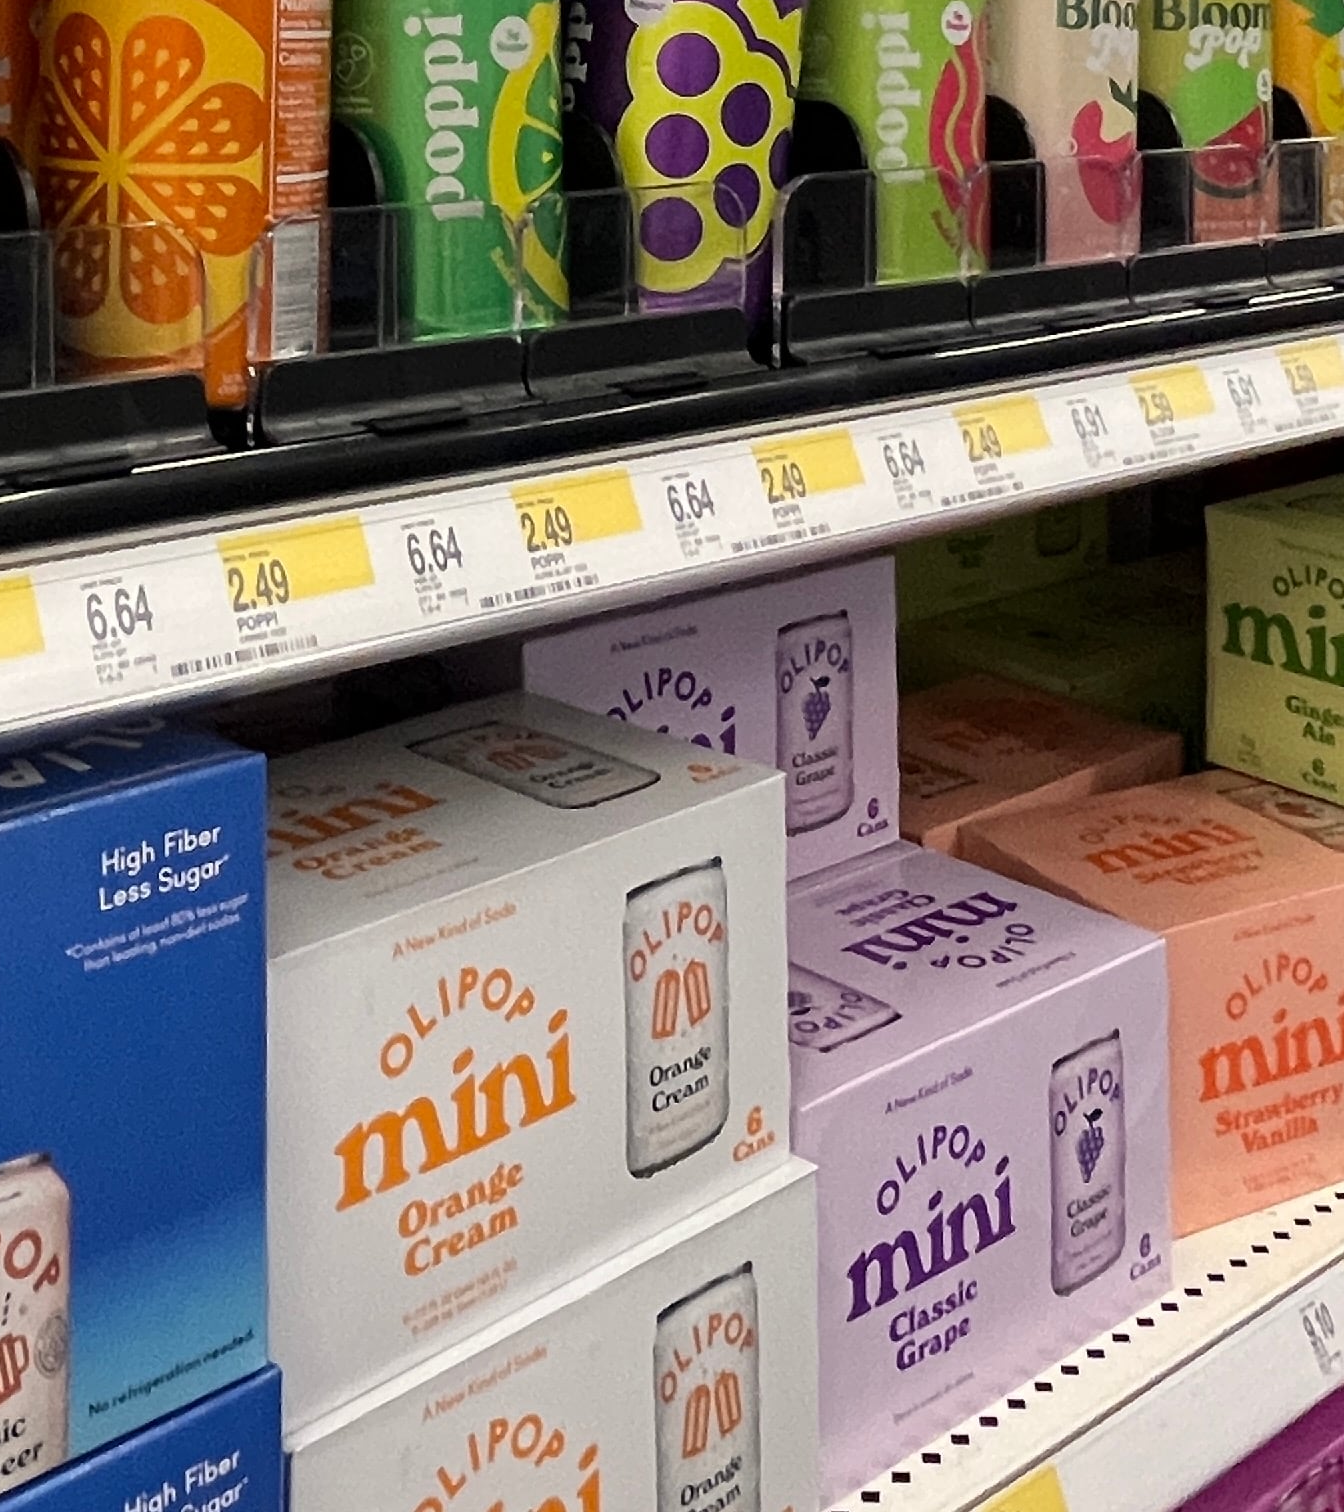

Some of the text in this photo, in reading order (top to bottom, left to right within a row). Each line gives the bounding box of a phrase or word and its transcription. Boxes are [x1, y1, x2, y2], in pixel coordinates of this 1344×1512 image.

[1183, 26, 1263, 72] Pop
[403, 10, 485, 223] poppi
[861, 8, 925, 185] poppi
[883, 439, 926, 480] 6.64
[961, 423, 1002, 462] 2.49
[666, 479, 716, 524] 6.64
[759, 462, 808, 506] 2.49
[406, 526, 463, 576] 6.64
[520, 505, 573, 555] 2.49
[86, 584, 154, 641] 6.64
[227, 558, 290, 614] 2.49
[236, 610, 280, 634] POPPI
[779, 639, 851, 695] OLIPOP
[1301, 719, 1337, 748] Ale
[865, 797, 880, 820] 6
[100, 824, 224, 879] High Fiber
[1084, 817, 1256, 875] mini
[97, 879, 153, 912] Less
[436, 920, 470, 947] Kind
[628, 900, 726, 983] OLIPOP
[841, 890, 1019, 972] mini
[1226, 950, 1330, 1023] OLIPOP
[379, 964, 536, 1080] OLIPOP
[647, 1043, 713, 1088] Orange
[650, 1070, 710, 1115] Cream
[332, 1007, 578, 1214] mini
[746, 1103, 764, 1136] 6
[1053, 1066, 1122, 1138] OLIPOP
[1213, 1082, 1344, 1140] Strawberry
[731, 1131, 777, 1164] Cans
[1239, 1114, 1321, 1155] Vanilla
[876, 1123, 987, 1217] OLIPOP
[397, 1160, 525, 1241] Orange
[402, 1203, 520, 1278] Cream
[846, 1155, 1017, 1323] mini
[888, 1276, 979, 1344] Classic
[660, 1311, 757, 1405] OLIPOP
[895, 1315, 973, 1373] Grape
[87, 1400, 111, 1419] No
[110, 1356, 204, 1414] refrigeration
[183, 1449, 242, 1495] Fiber
[679, 1451, 744, 1508] Orange
